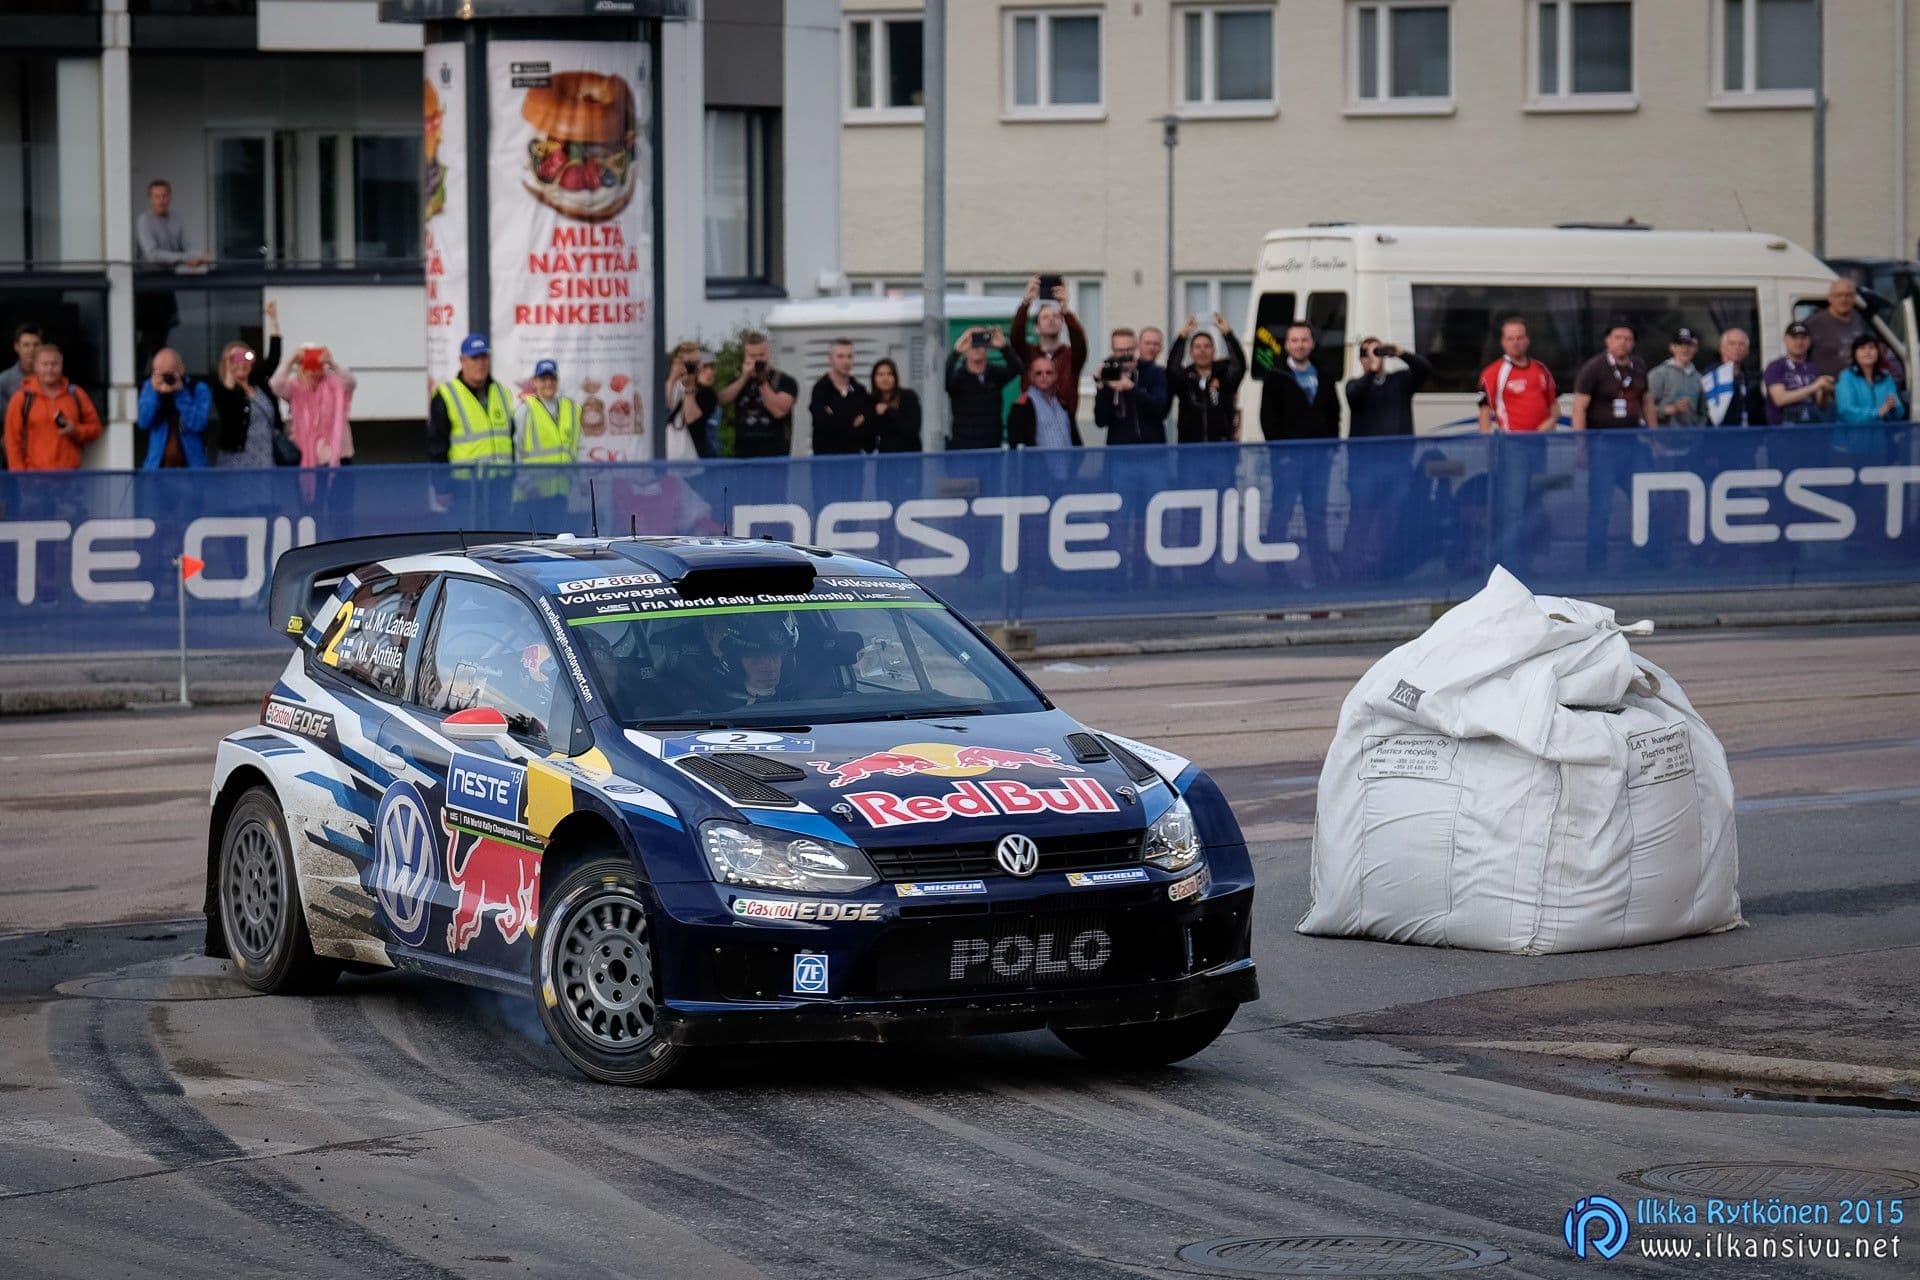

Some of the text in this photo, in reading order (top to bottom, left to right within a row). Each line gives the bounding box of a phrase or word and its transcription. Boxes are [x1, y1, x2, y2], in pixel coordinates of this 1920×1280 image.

[552, 222, 625, 247] MILTÄ
[548, 279, 629, 298] SINUN
[1146, 487, 1300, 567] OIL
[823, 578, 921, 591] Volkswagen
[558, 586, 678, 605] Volkswagen
[642, 601, 669, 611] FIA
[674, 597, 715, 608] World
[718, 594, 754, 605] Rally
[755, 591, 854, 603] Championship
[322, 600, 354, 667] 2
[385, 611, 420, 638] Latvala
[355, 640, 403, 669] M. Anttila
[539, 595, 593, 704] www.volkswagen-motorsport.com
[1393, 686, 1416, 706] L&T
[291, 708, 332, 738] EDGE
[730, 734, 748, 743] 2
[1631, 738, 1647, 750] L&T
[1376, 748, 1437, 758] Plastics recycling
[453, 768, 510, 805] NESTE
[511, 770, 520, 784] '15
[845, 778, 1119, 827] Red Bull
[463, 816, 471, 824] FIA
[471, 816, 481, 827] World
[482, 821, 493, 834] Rally
[492, 823, 521, 841] Championship
[1093, 871, 1144, 881] MICHELIN
[924, 883, 982, 892] MICHELIN
[746, 901, 884, 921] Castrol EDGE
[950, 930, 1112, 979] POLO
[800, 963, 823, 984] ZF
